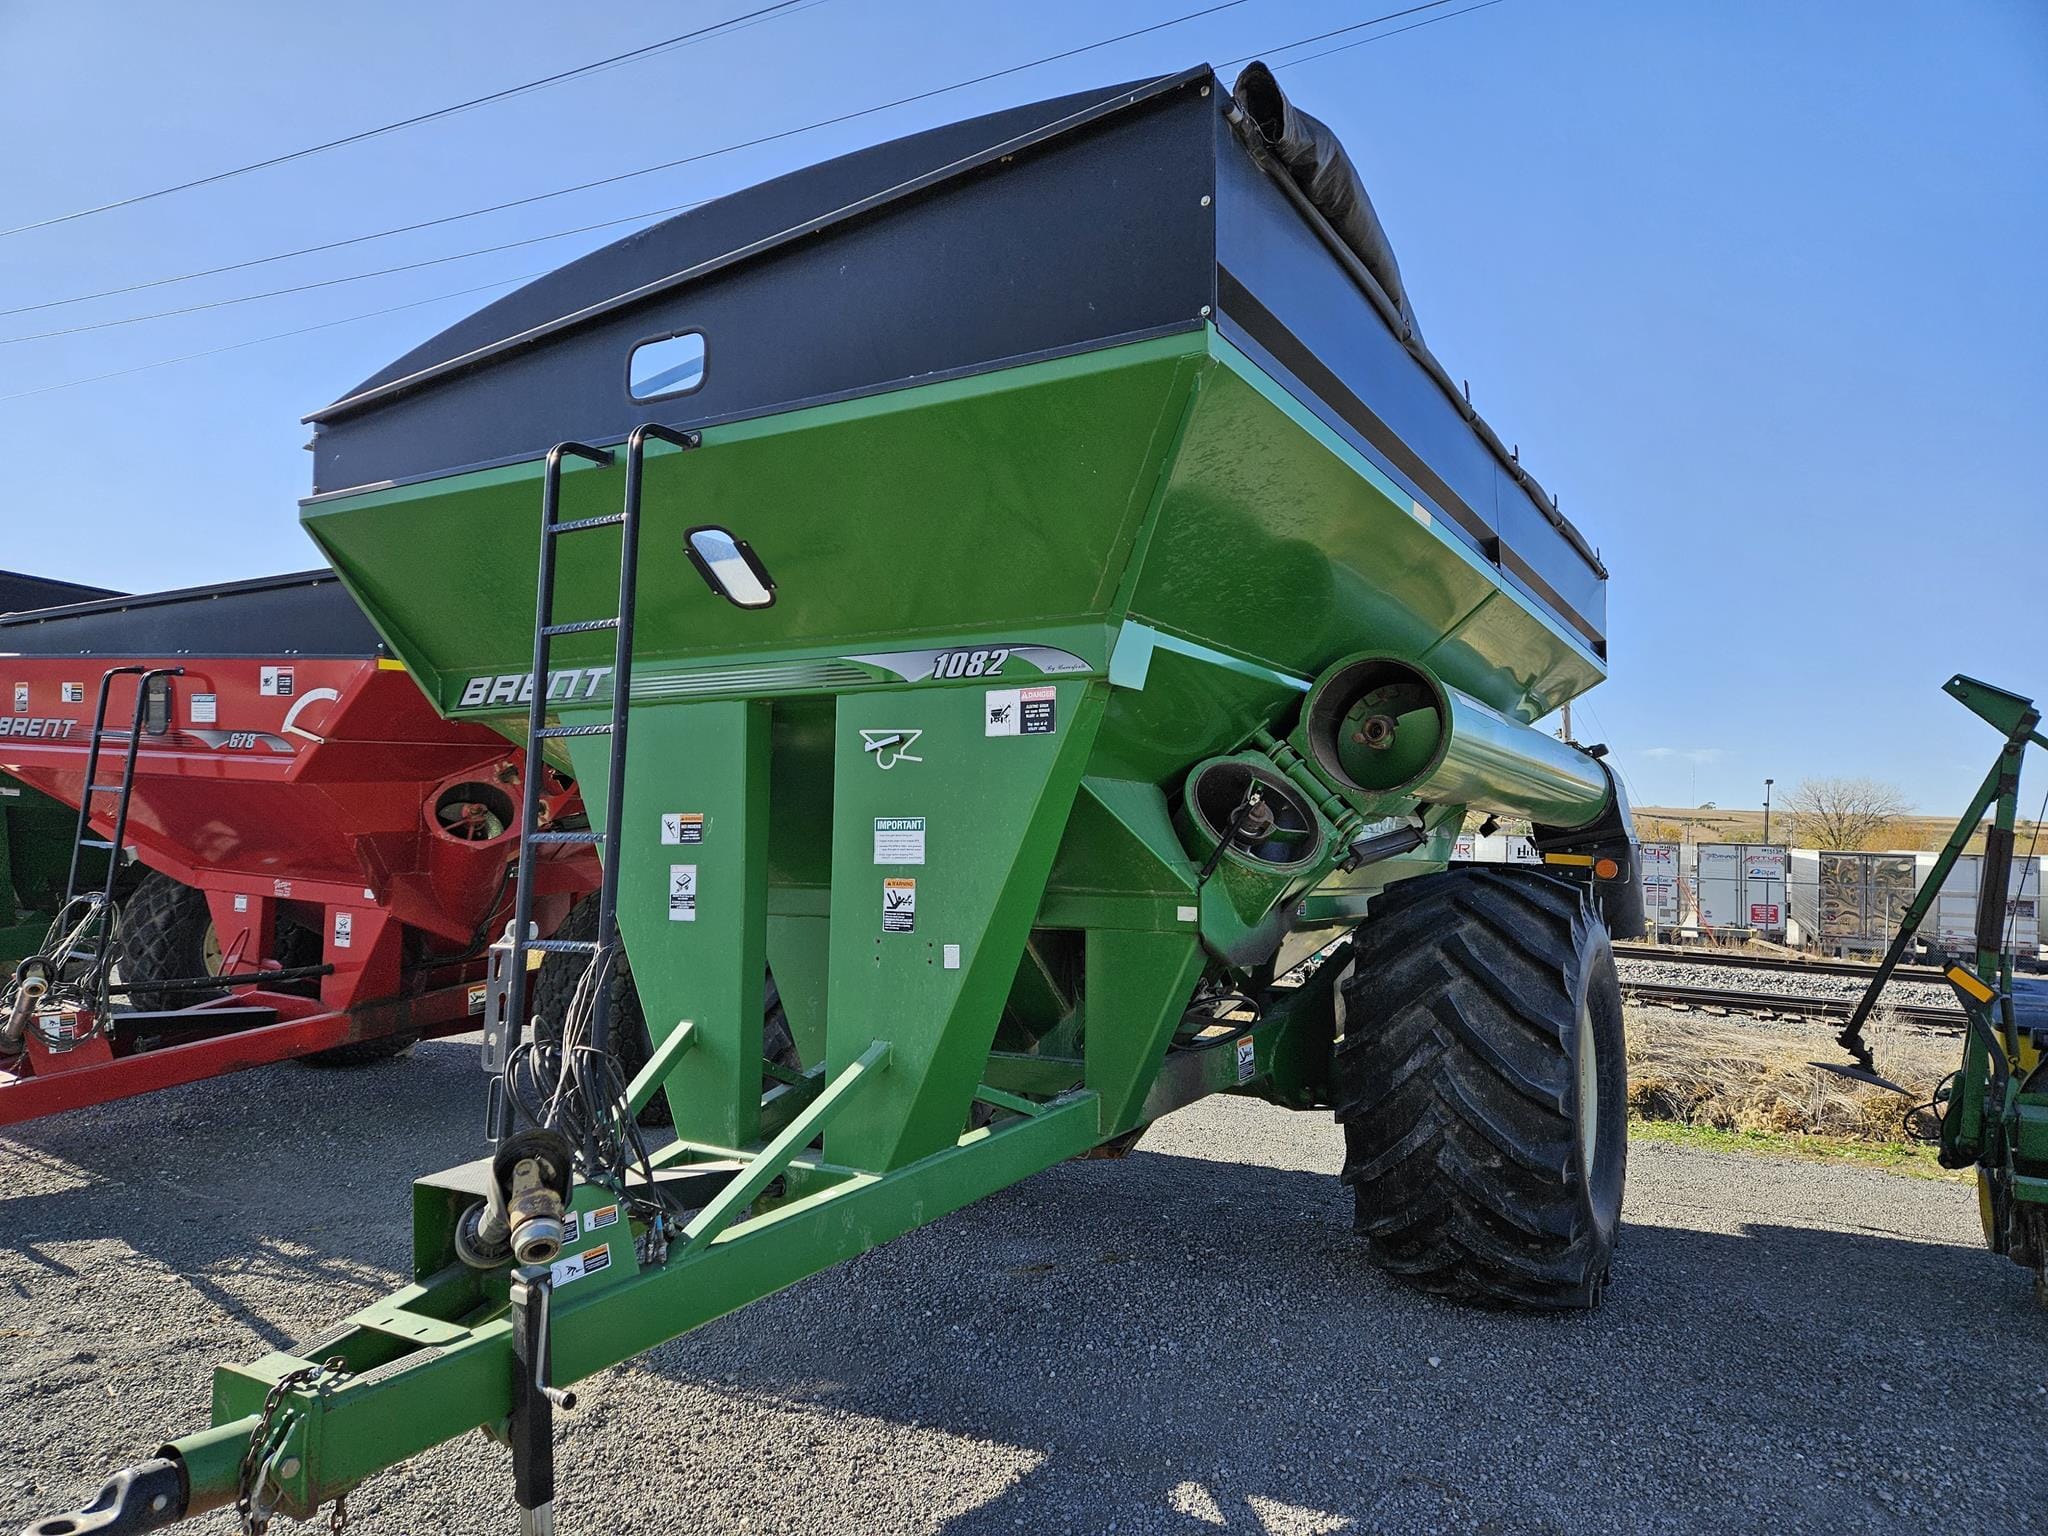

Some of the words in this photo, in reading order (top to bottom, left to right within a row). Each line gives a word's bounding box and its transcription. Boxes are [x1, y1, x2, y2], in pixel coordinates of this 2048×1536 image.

[932, 649, 1010, 680] 1082
[0, 716, 78, 738] BRENT
[228, 732, 257, 749] 678
[877, 820, 923, 831] IMPORTANT
